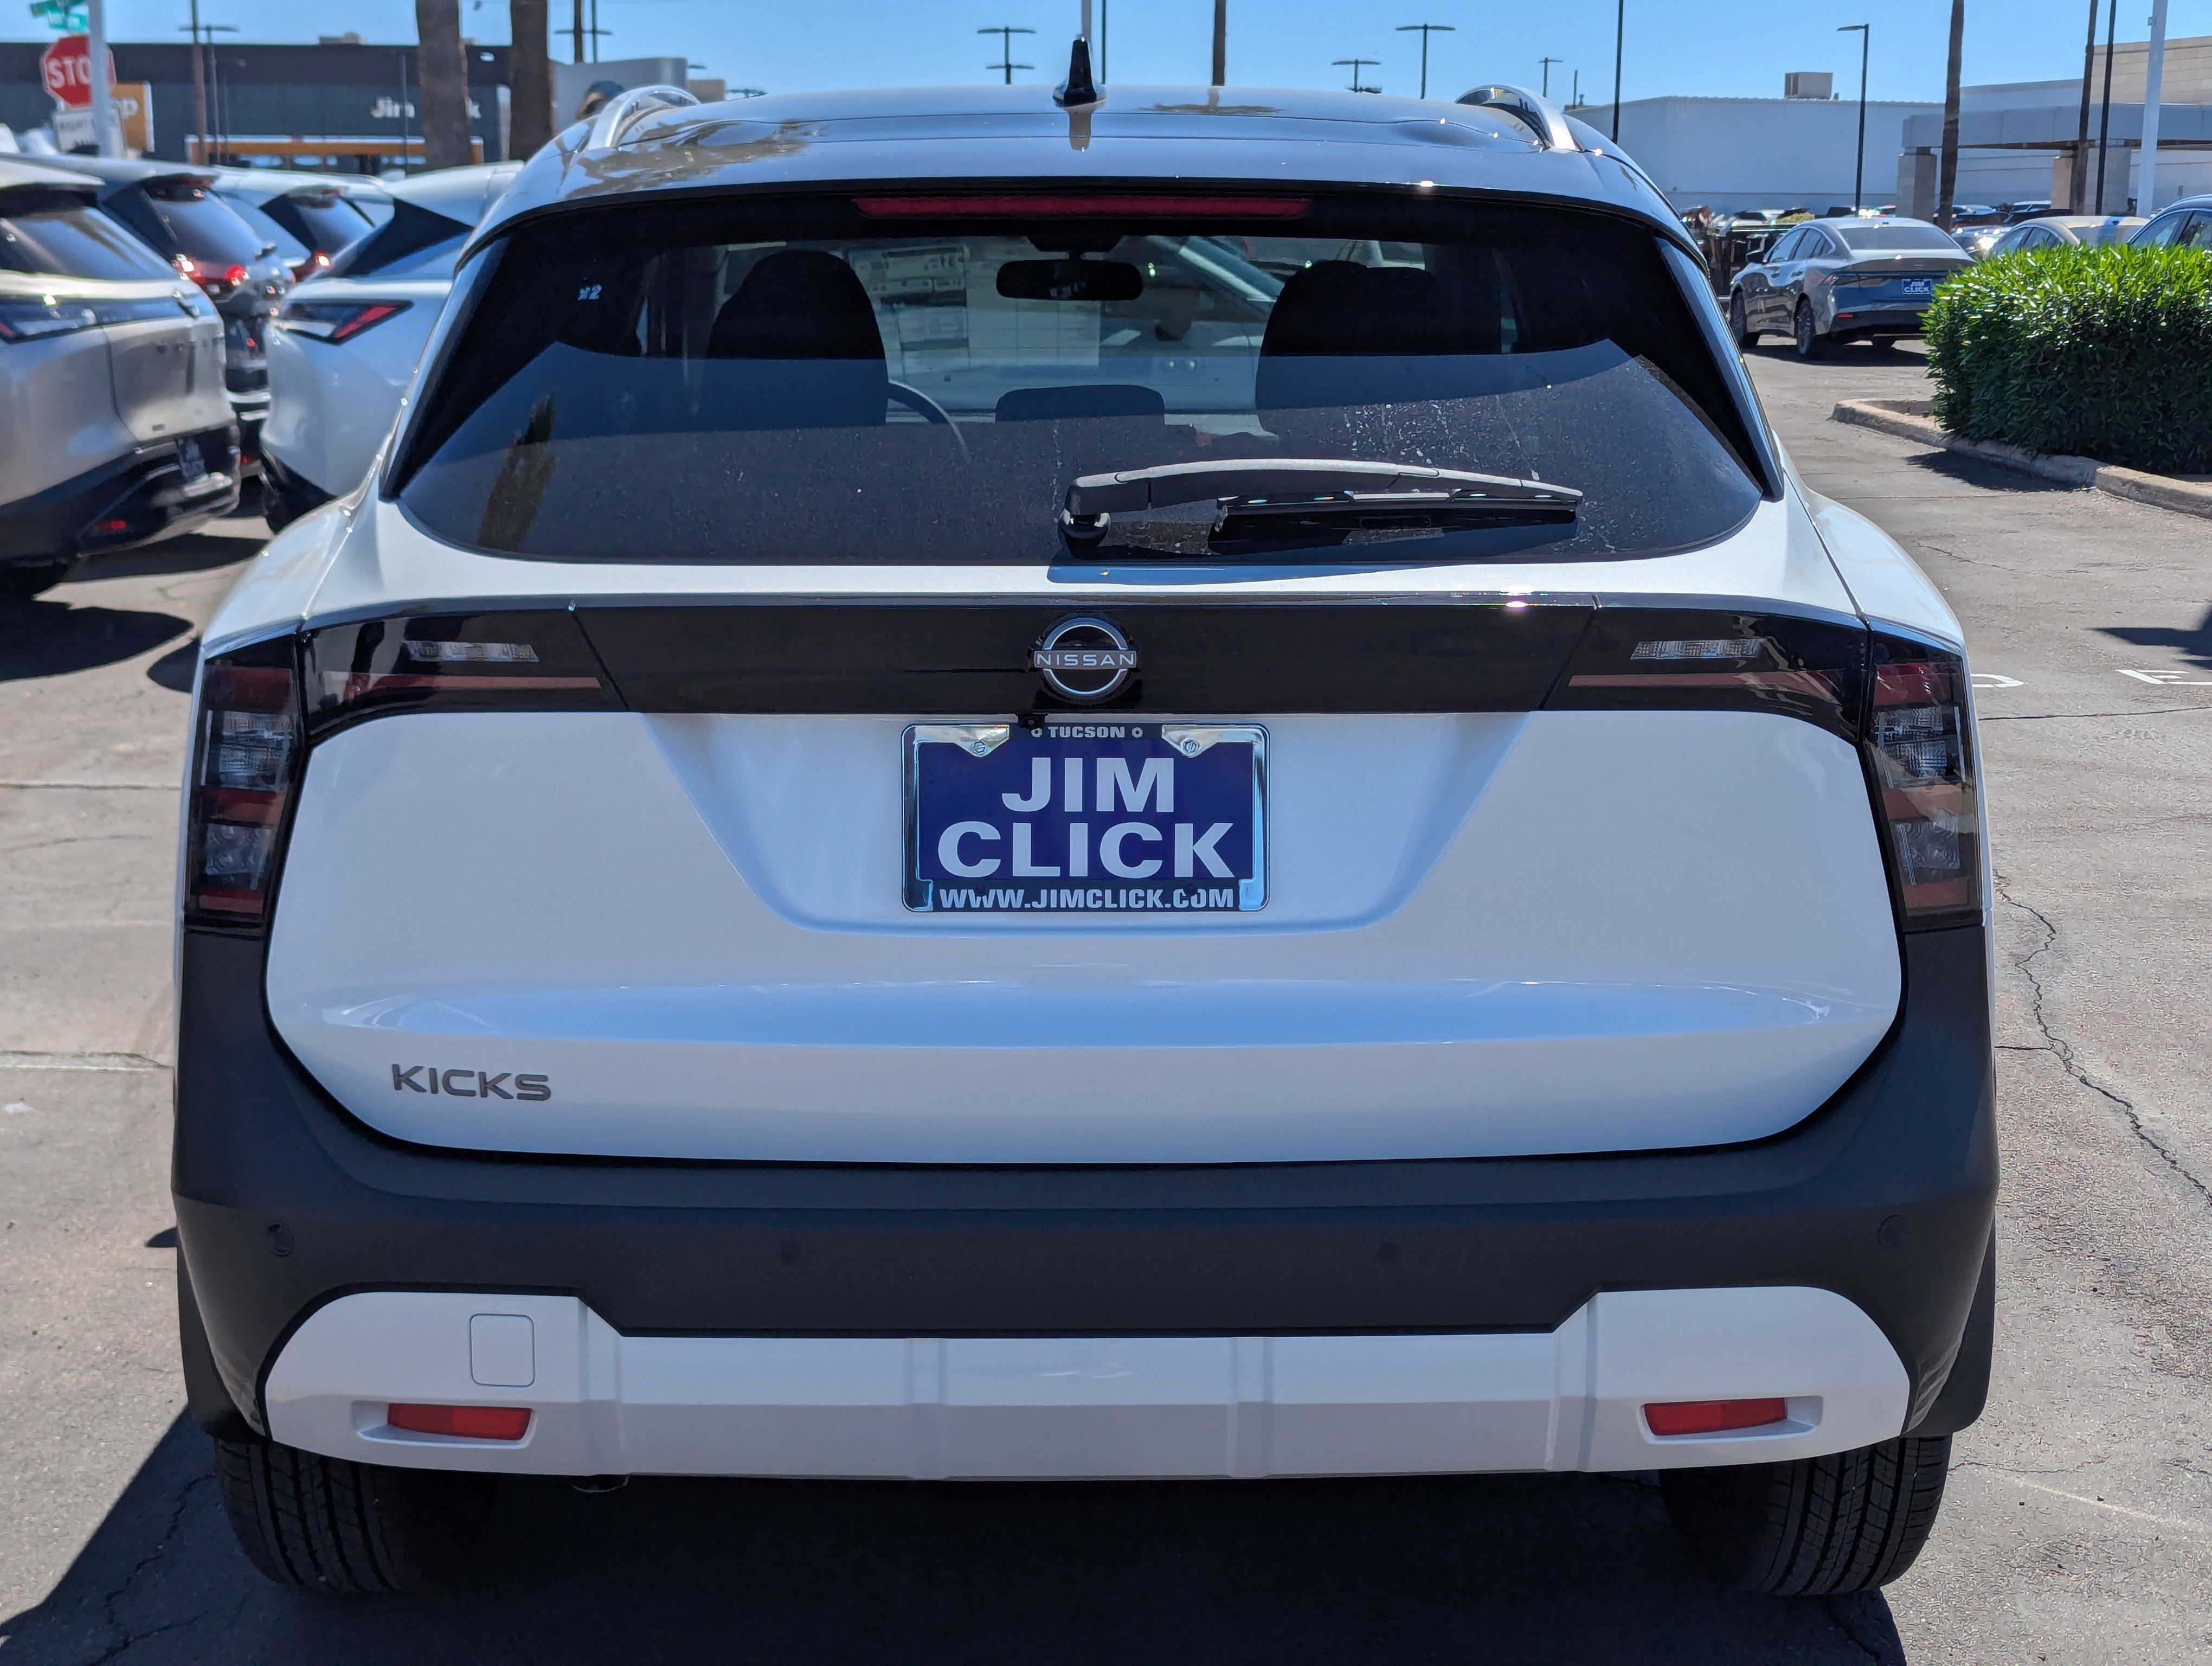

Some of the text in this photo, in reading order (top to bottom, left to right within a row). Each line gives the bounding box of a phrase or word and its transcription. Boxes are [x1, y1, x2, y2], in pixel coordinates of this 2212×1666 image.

[48, 55, 91, 88] STO
[370, 96, 415, 118] Jim
[1037, 653, 1134, 666] NISSAN
[1048, 726, 1126, 739] TUCSON
[1001, 757, 1174, 812] JIM
[938, 821, 1236, 878] CLICK
[939, 888, 1234, 908] WWW.JIMCLICK.COM
[392, 1063, 551, 1101] KICKS
